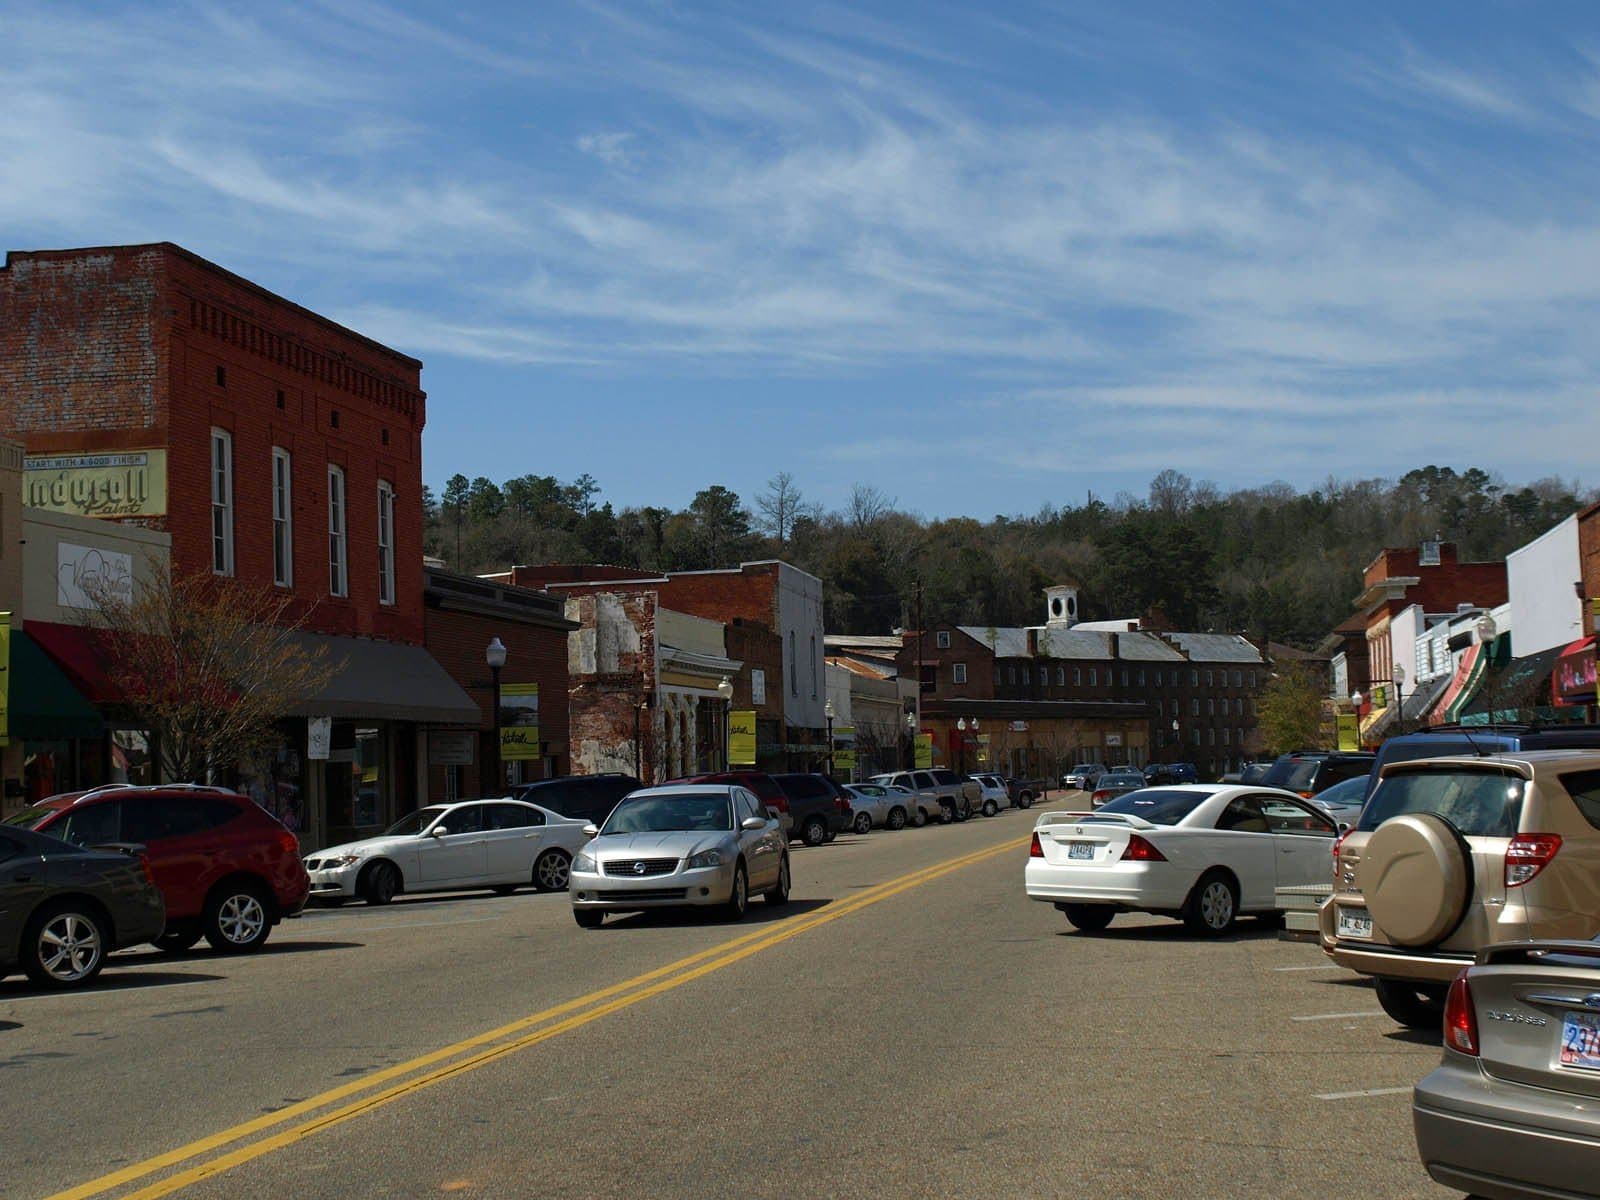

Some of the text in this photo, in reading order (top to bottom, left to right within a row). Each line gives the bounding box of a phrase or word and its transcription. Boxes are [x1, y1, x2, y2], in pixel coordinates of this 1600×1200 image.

[27, 459, 51, 468] START
[55, 458, 76, 467] WITH
[88, 457, 110, 466] GOOD
[113, 456, 141, 465] FINISH
[78, 499, 142, 514] Paint
